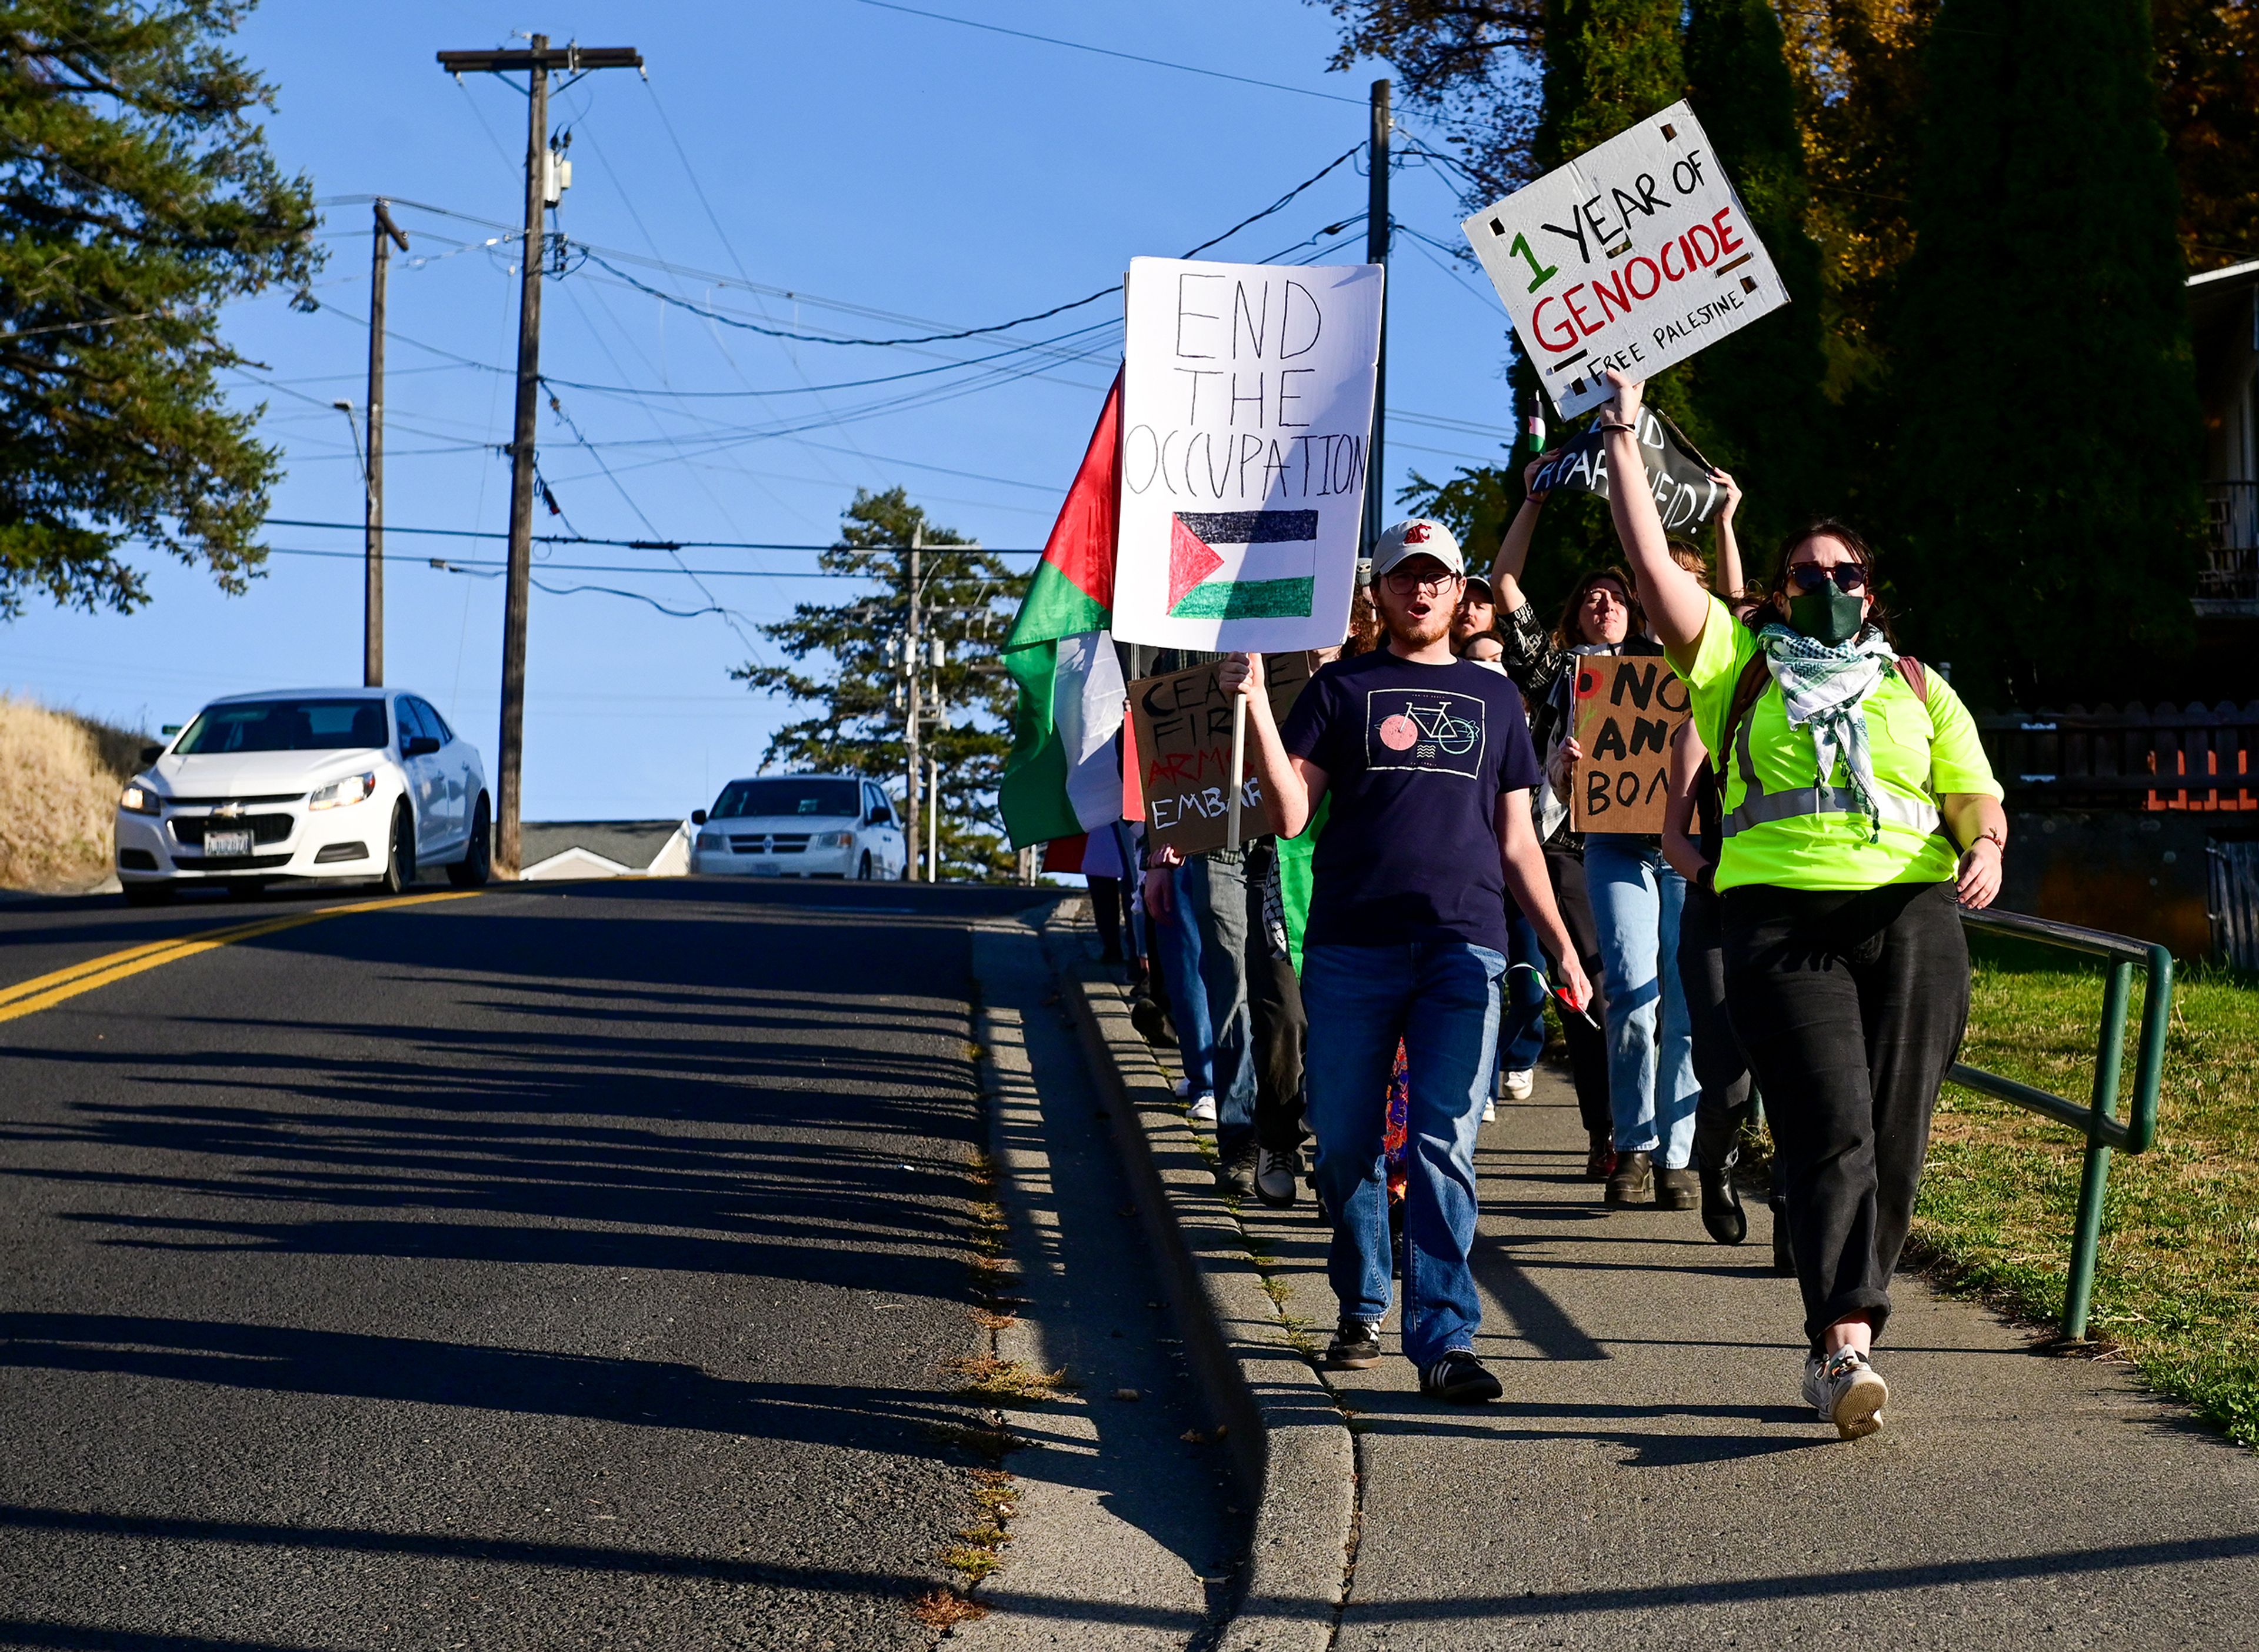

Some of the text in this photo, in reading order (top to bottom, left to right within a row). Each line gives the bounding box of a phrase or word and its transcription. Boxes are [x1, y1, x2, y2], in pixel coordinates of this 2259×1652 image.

[1510, 150, 1704, 293] 1 YEAR OF
[1177, 273, 1321, 360] END
[1532, 207, 1744, 353] GENOCIDE
[1587, 291, 1744, 386] FREE PALESTINE
[1174, 368, 1315, 429] THE
[1124, 424, 1370, 501] OCCUPATION
[1141, 652, 1304, 716] CEAE
[1610, 662, 1691, 712] NO
[1591, 716, 1682, 761] AN
